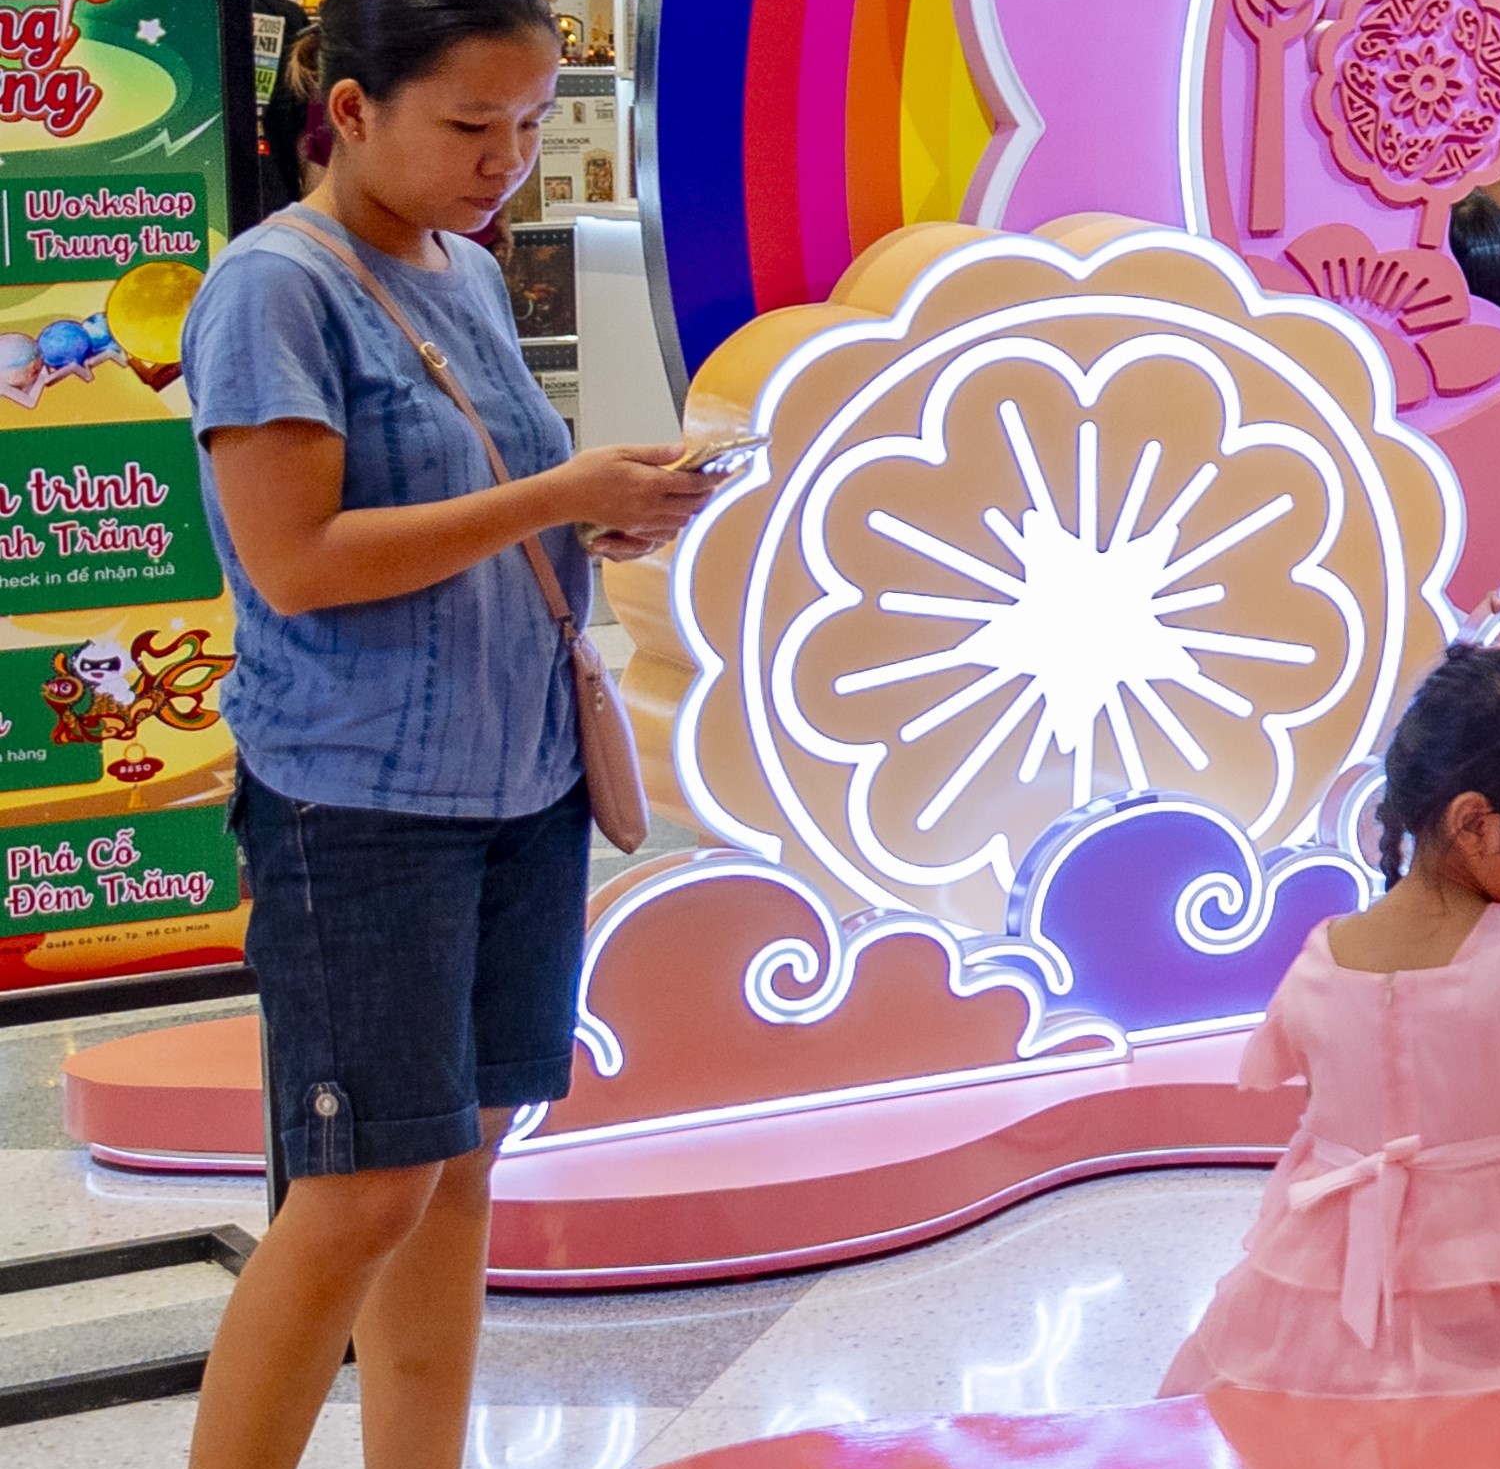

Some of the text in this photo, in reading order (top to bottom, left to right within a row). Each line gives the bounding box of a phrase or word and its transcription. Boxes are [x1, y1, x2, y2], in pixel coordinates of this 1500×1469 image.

[25, 187, 197, 223] Workshop
[26, 226, 200, 266] Trung thu
[26, 461, 170, 516] trình
[49, 517, 174, 558] Trăng
[45, 568, 62, 585] in
[66, 565, 91, 583] để
[94, 564, 139, 583] nhận
[142, 561, 176, 578] quà
[7, 746, 48, 763] hàng
[7, 828, 140, 881] Phá Cỗ
[5, 868, 215, 918] Đêm Trăng
